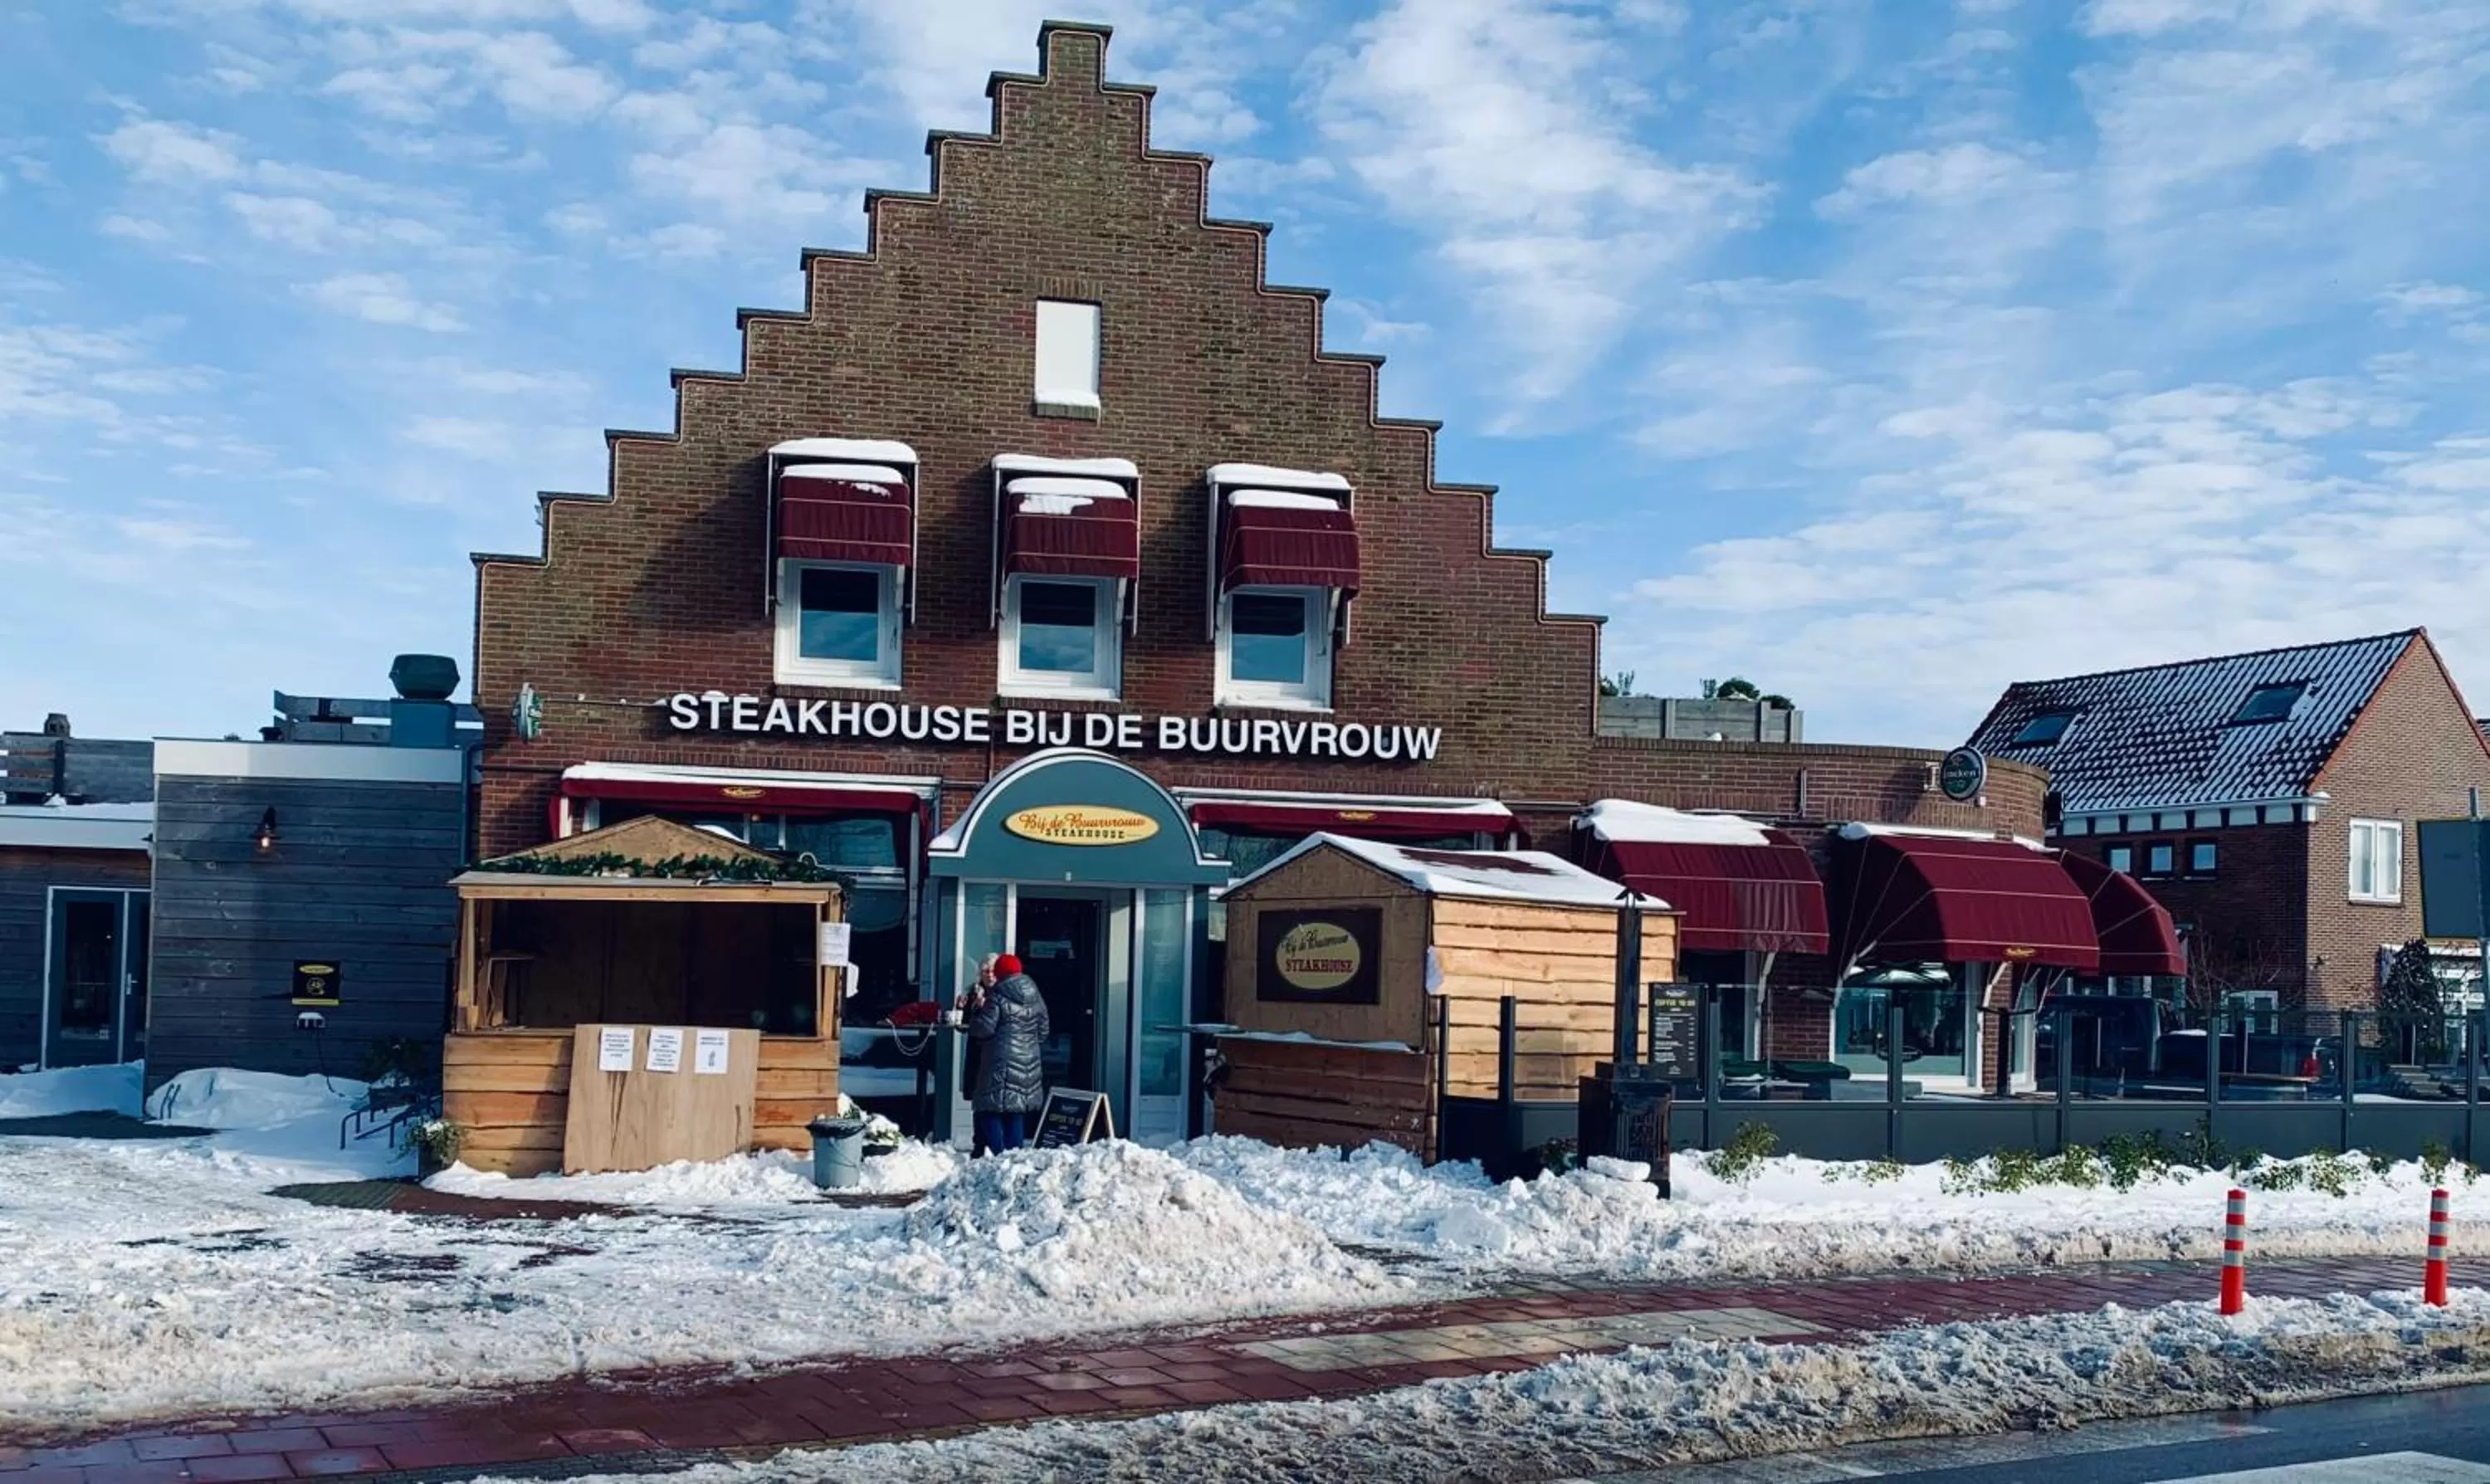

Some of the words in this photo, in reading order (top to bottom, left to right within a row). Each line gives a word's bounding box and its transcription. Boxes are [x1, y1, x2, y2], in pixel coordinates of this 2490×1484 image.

[669, 692, 990, 741] STEAKHOUSE
[1007, 710, 1071, 745] BIJ
[1085, 713, 1143, 747] DE
[1159, 716, 1442, 759] BUURVROUW
[1019, 813, 1047, 834] Bij
[1049, 814, 1062, 828] de
[1046, 828, 1125, 839] STEAKHOUSE
[1286, 959, 1353, 973] STEAKHOUSE
